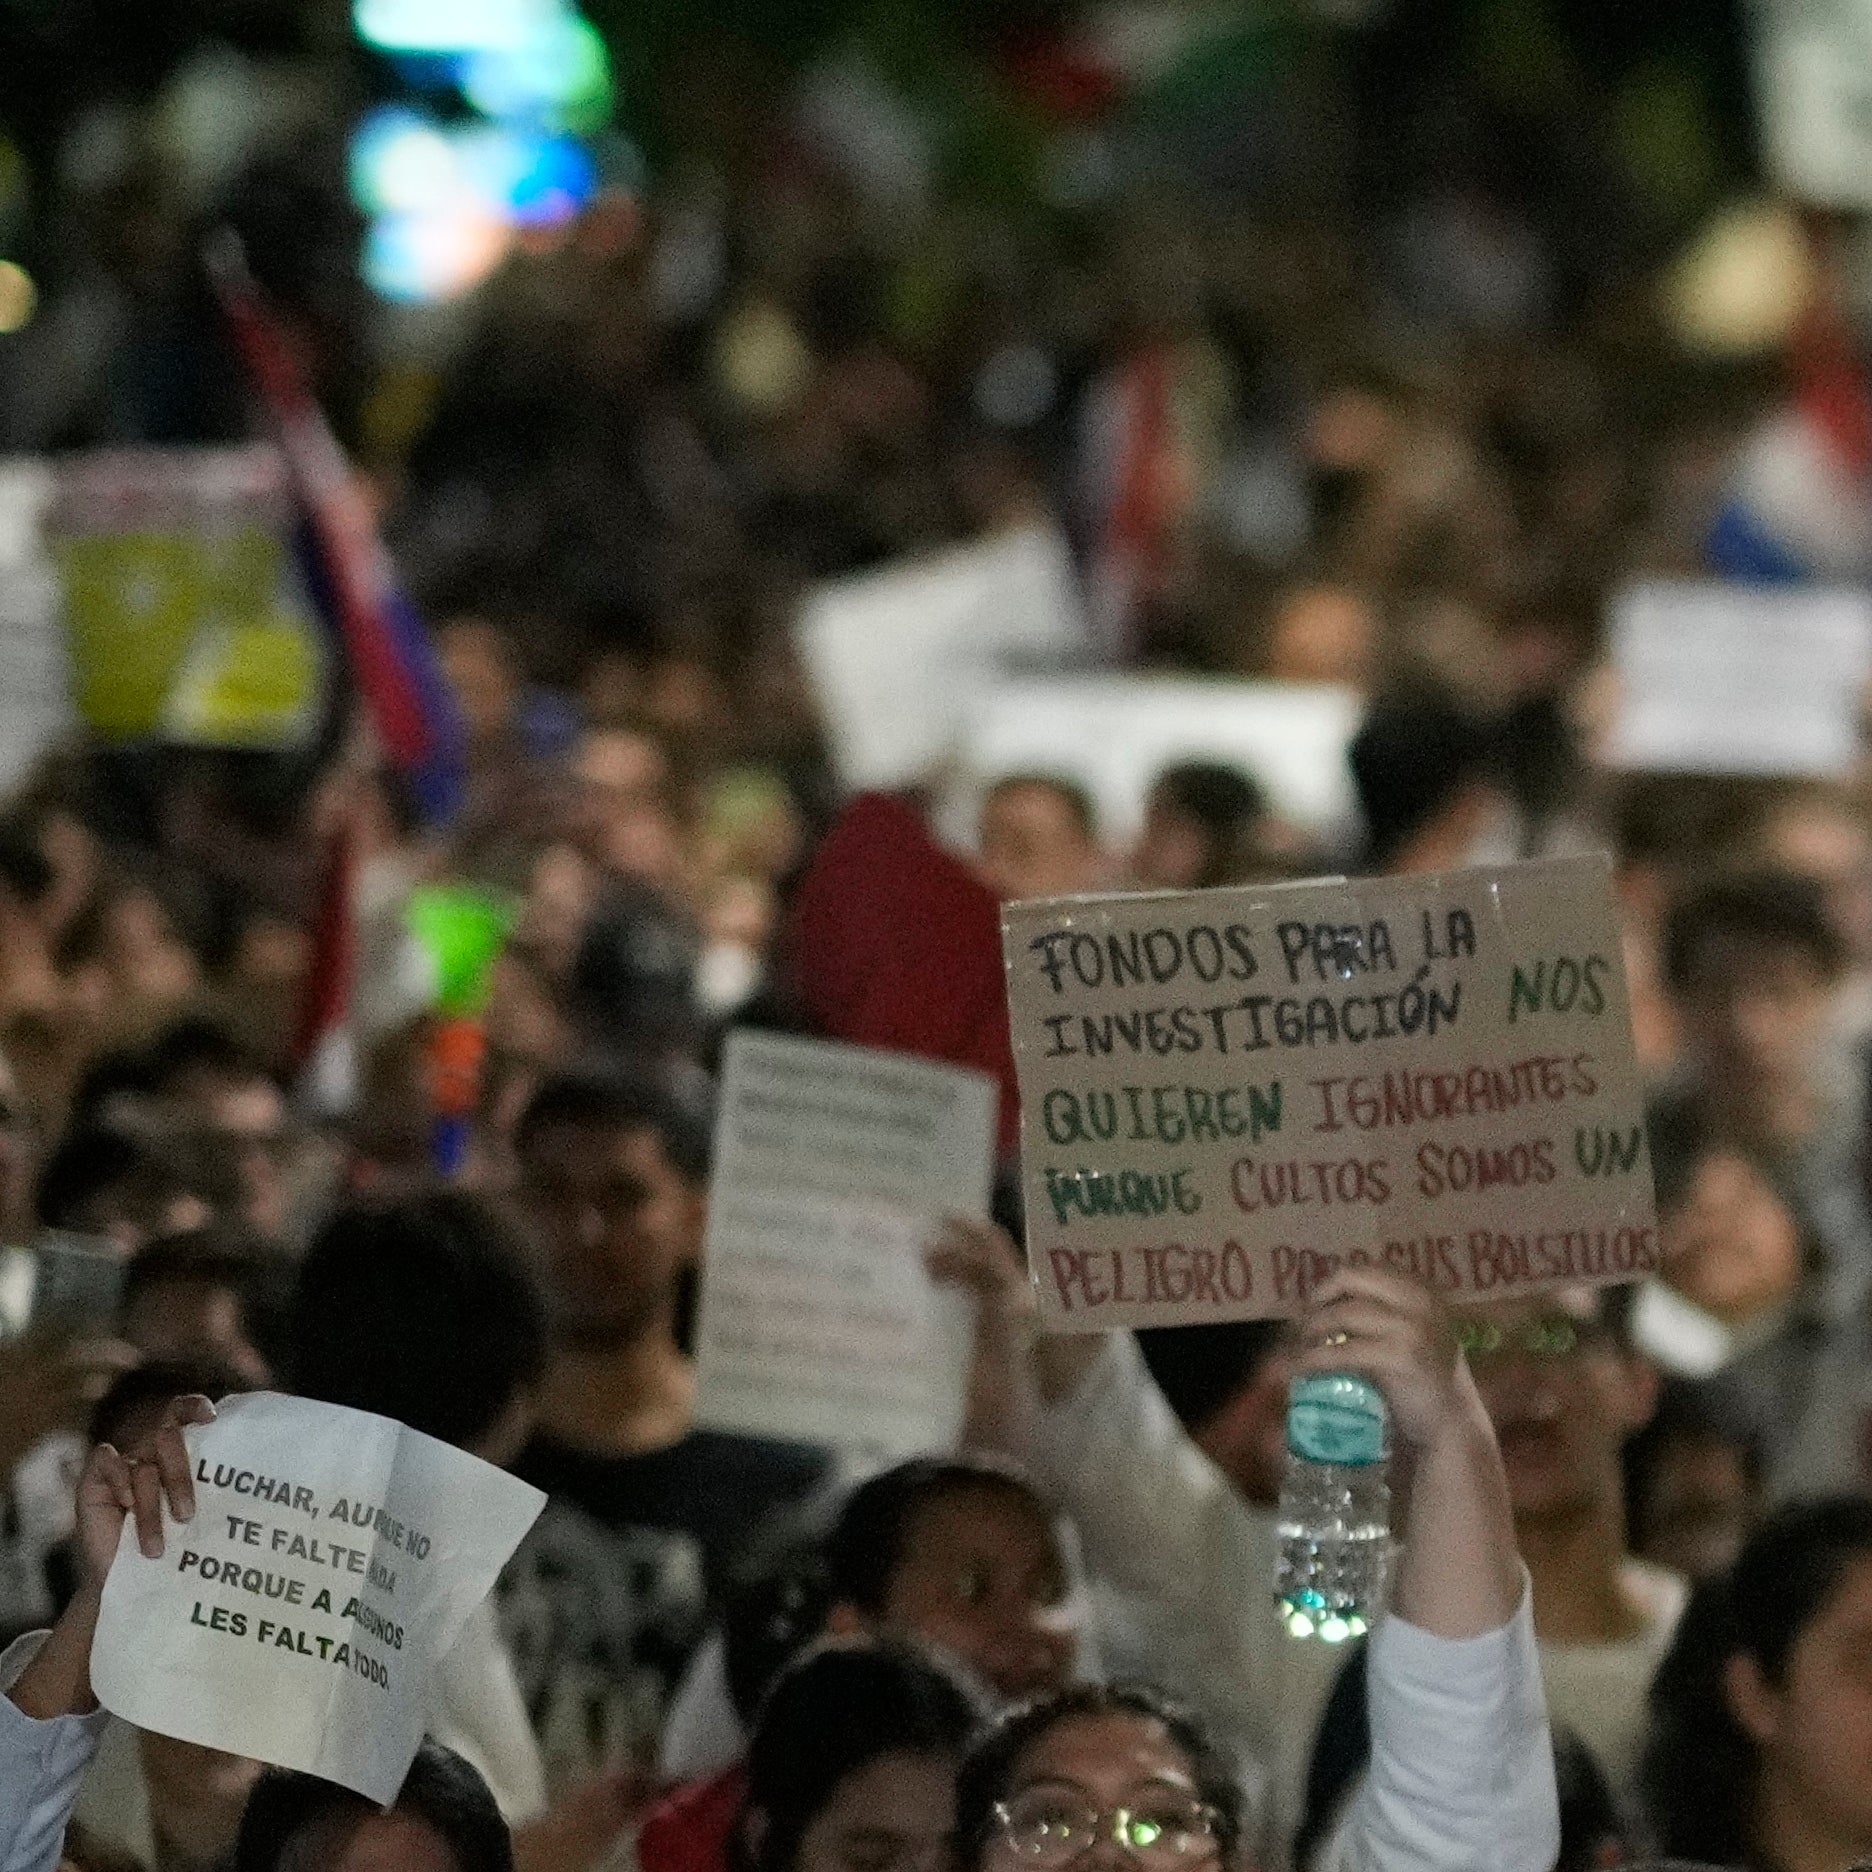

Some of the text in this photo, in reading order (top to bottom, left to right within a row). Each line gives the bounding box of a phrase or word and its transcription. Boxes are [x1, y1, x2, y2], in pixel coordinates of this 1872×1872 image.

[1030, 907, 1478, 994] FONDOS PARA LA
[1043, 954, 1610, 1058] INVESTIGACIÓN NOS
[1042, 1053, 1598, 1147] QUIEREN IGNORANTES
[1230, 1156, 1391, 1213] CULTOS
[1416, 1140, 1557, 1199] SOMOS
[1573, 1124, 1641, 1178] UN
[1049, 1243, 1253, 1310] PELIGRO
[196, 1458, 320, 1520] LUCHAR,
[405, 1528, 432, 1561] NO
[226, 1514, 264, 1547] TE
[271, 1528, 367, 1575] FALTE
[178, 1549, 306, 1606] PORQUE
[311, 1588, 332, 1615] A
[190, 1601, 249, 1637] LES
[257, 1618, 350, 1669] FALTA
